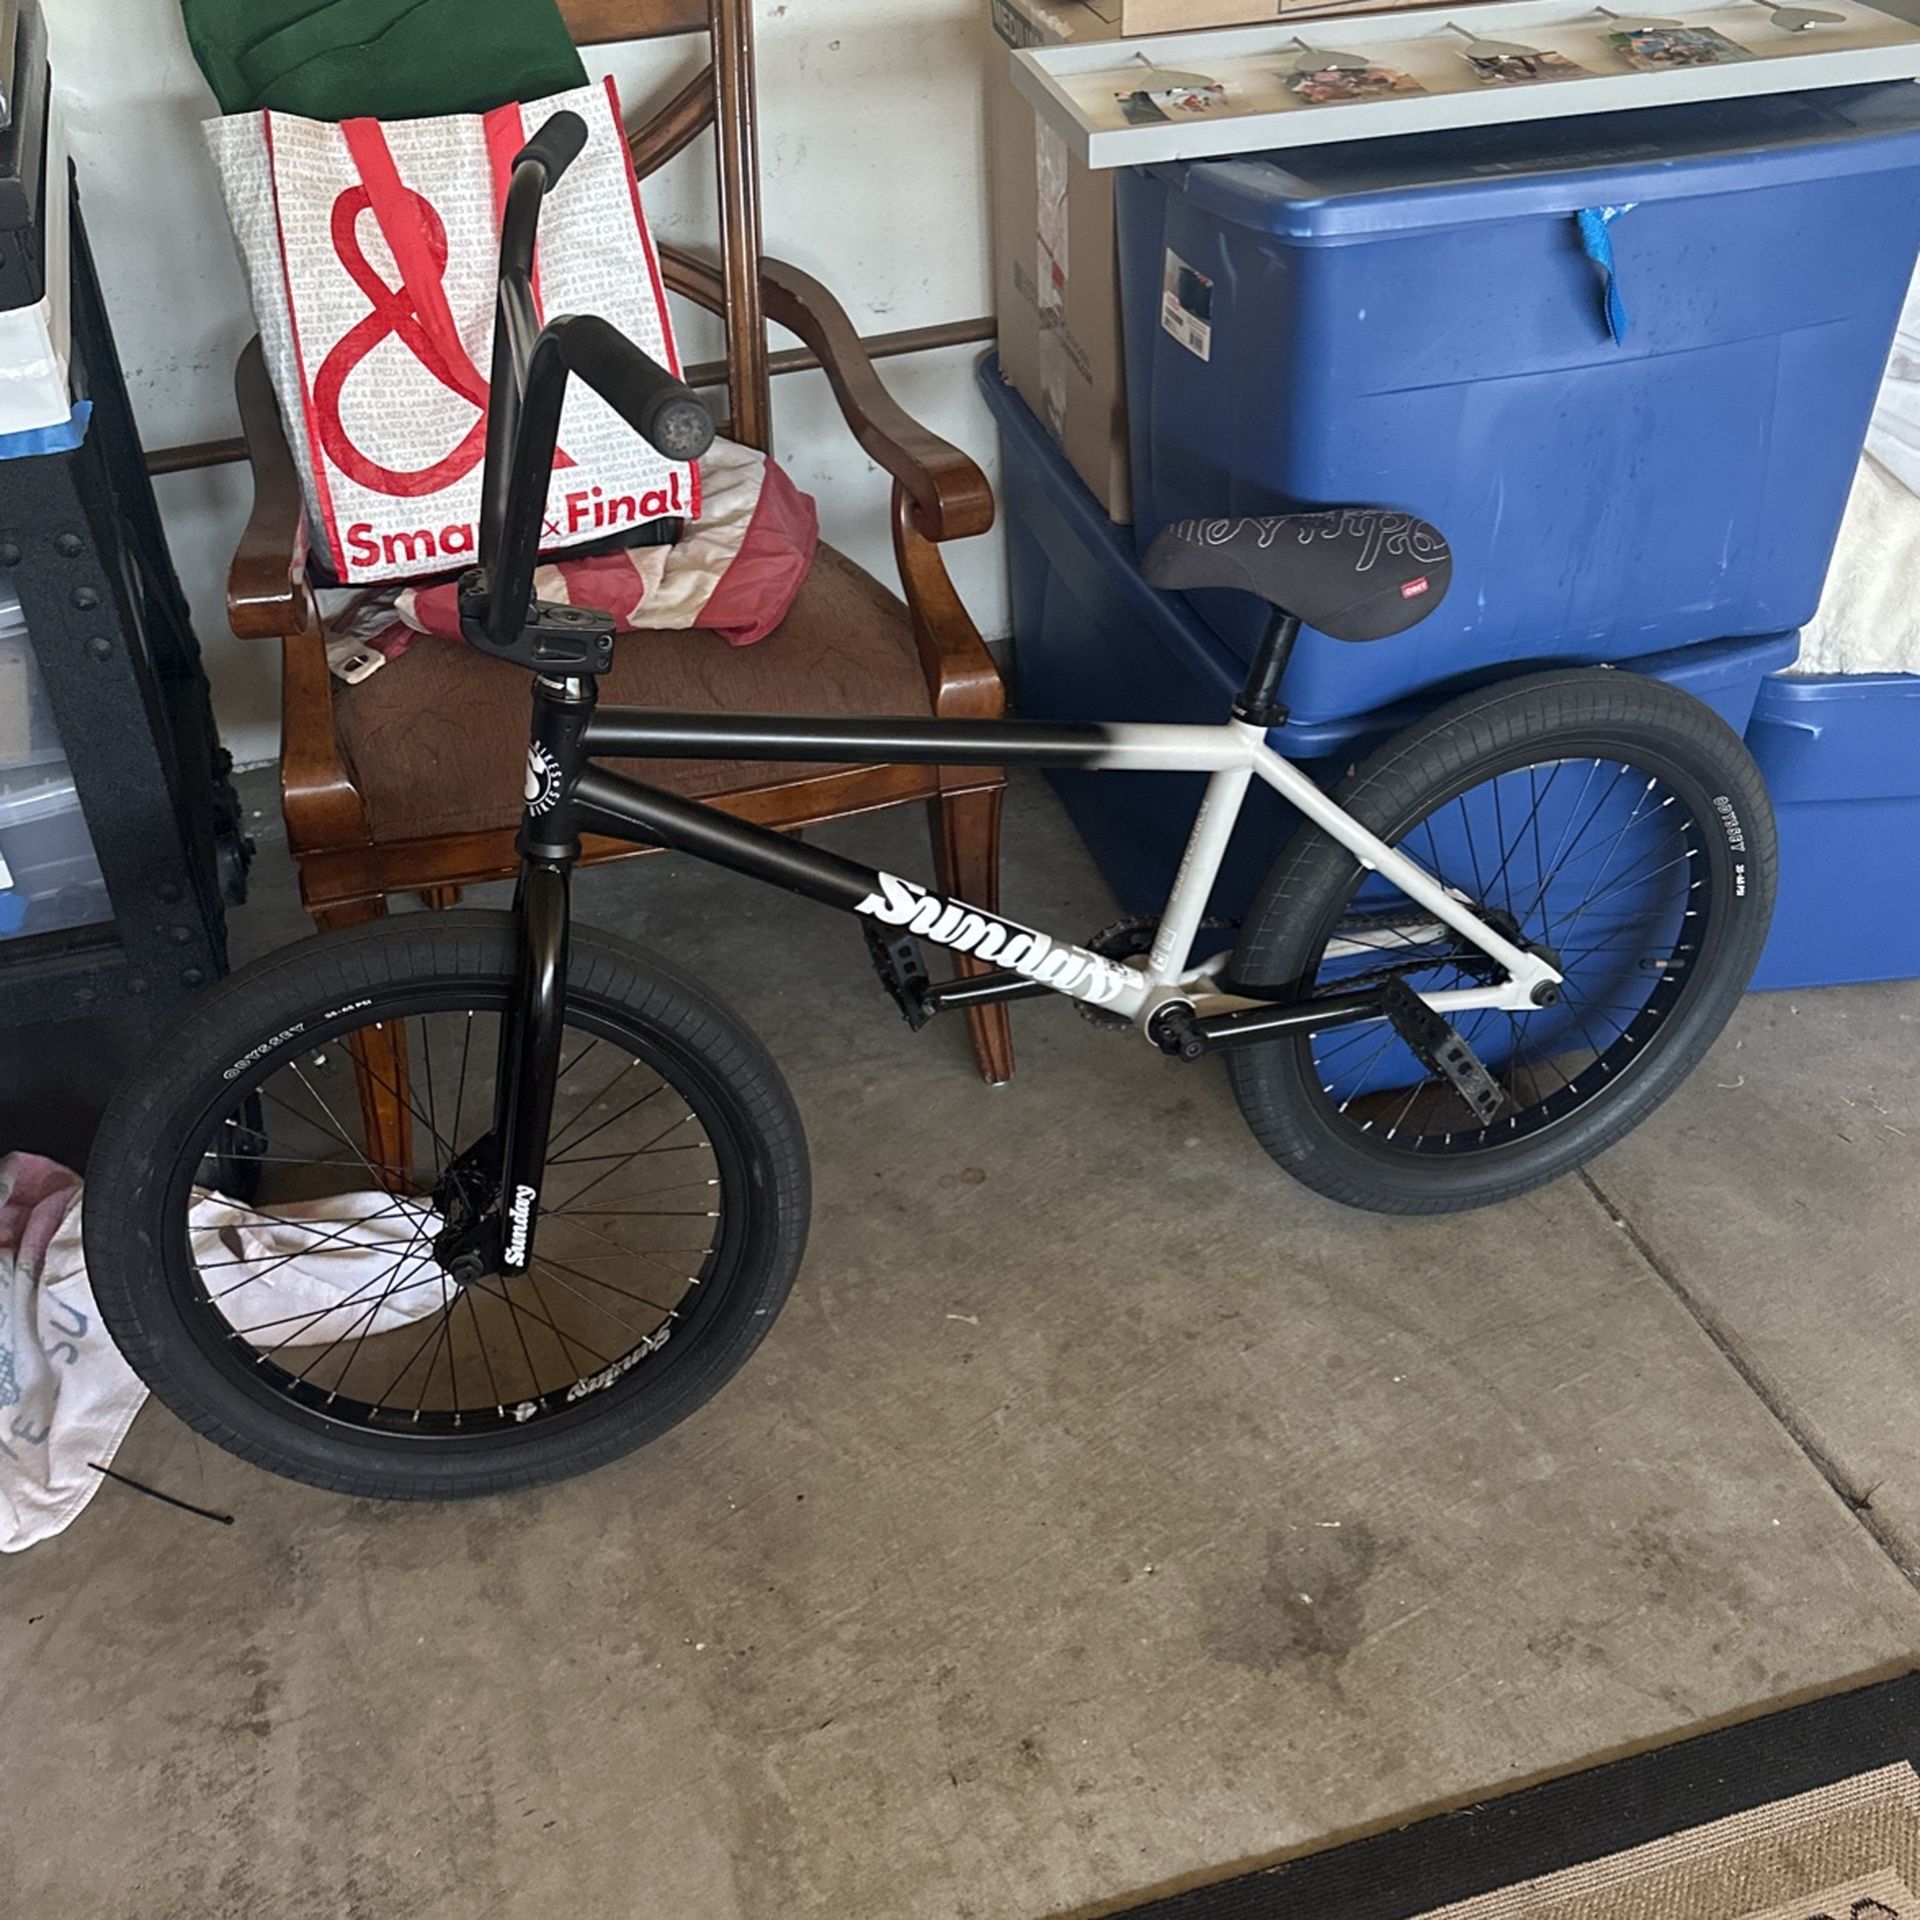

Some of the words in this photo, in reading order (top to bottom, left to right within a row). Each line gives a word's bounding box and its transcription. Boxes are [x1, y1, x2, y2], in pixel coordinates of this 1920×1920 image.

[346, 522, 480, 568] Sma
[565, 472, 682, 533] Final
[503, 1184, 537, 1268] Sunday
